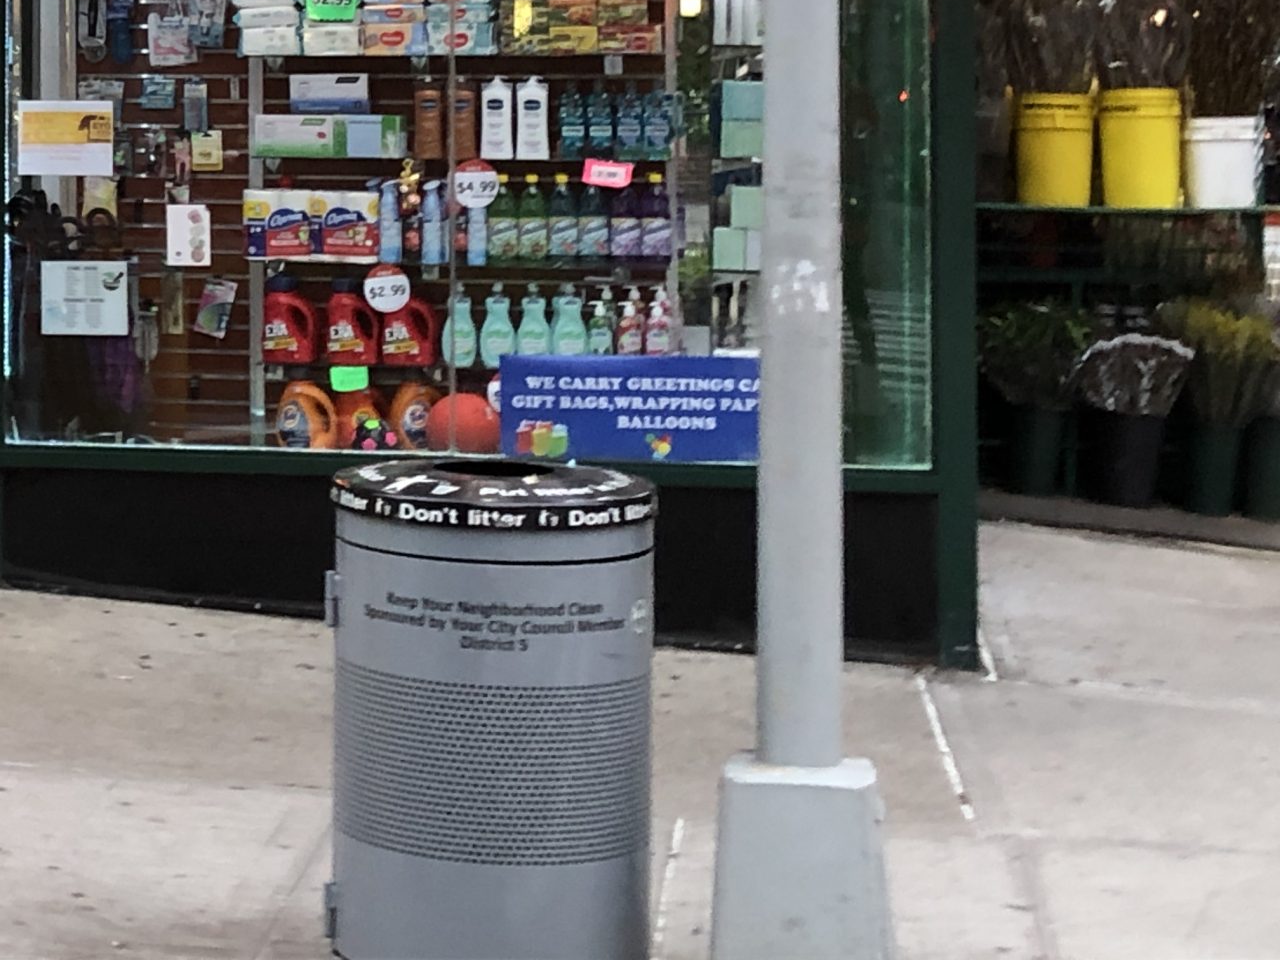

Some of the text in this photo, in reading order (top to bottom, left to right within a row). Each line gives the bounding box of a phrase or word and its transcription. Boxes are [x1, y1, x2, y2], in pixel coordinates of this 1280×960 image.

[525, 376, 555, 390] WE
[558, 376, 623, 390] CARRY
[627, 377, 735, 392] GREETINGS
[511, 395, 555, 409] GIFT
[616, 415, 718, 430] BALLOONS
[398, 502, 460, 525] Don't
[568, 506, 622, 527] Don't
[386, 592, 419, 611] Keep
[568, 601, 604, 616] Clean
[487, 620, 518, 636] City
[520, 621, 575, 635] Council
